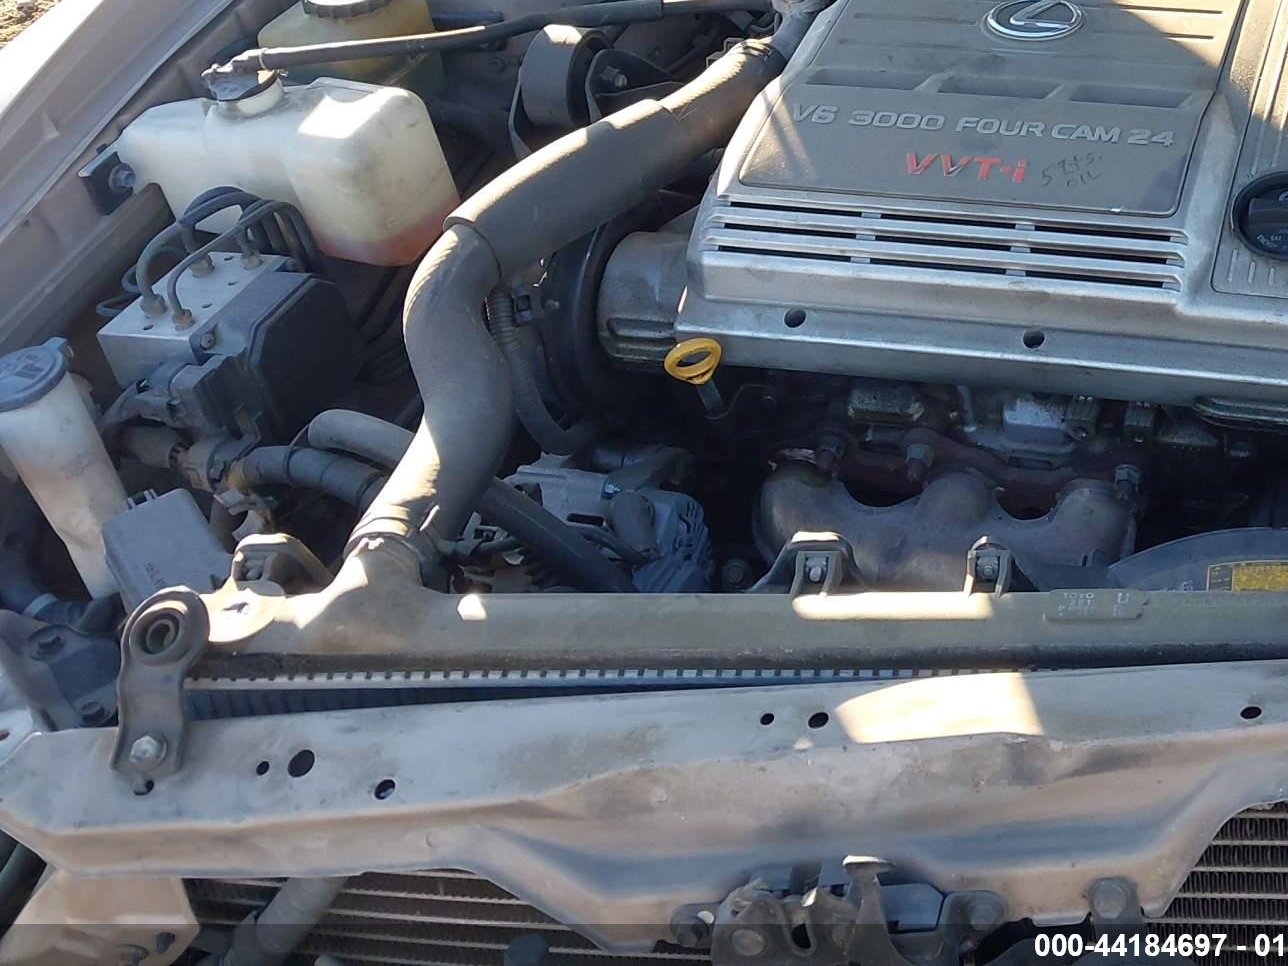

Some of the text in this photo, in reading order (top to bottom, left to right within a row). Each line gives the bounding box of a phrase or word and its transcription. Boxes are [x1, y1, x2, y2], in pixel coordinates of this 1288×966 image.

[793, 104, 1175, 148] V6 3000 FOUR CAM 24
[906, 151, 1029, 183] VVT-i
